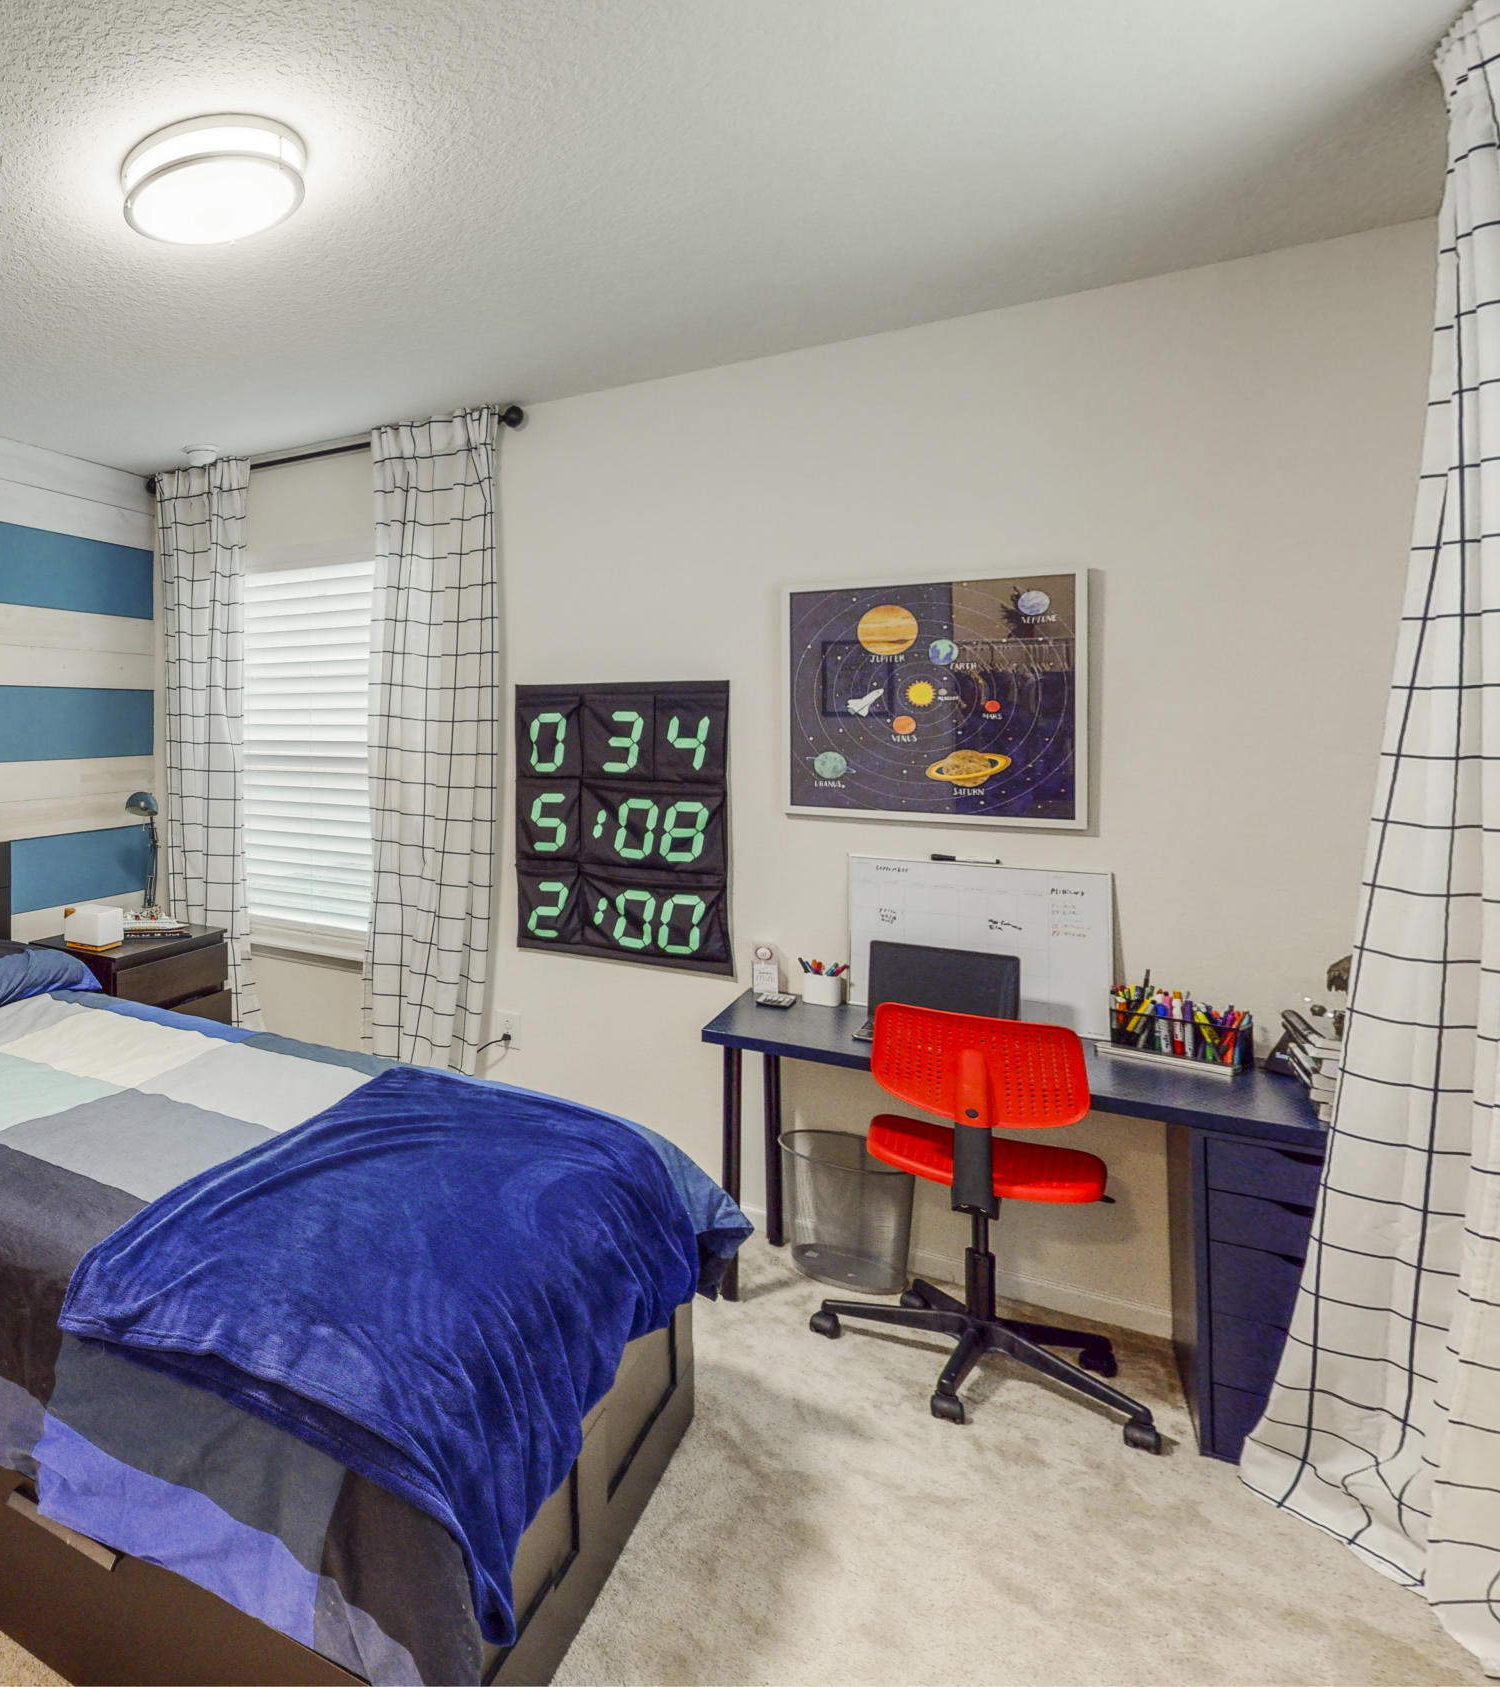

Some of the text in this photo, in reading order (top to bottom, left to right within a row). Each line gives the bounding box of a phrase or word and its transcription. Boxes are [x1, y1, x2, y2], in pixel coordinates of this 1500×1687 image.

[1021, 614, 1057, 624] NEPTUNE
[869, 654, 906, 664] JUPITER
[950, 662, 977, 671] EARTH
[982, 712, 1003, 720] MARS
[891, 734, 918, 743] VENUS
[952, 787, 985, 796] SATURN
